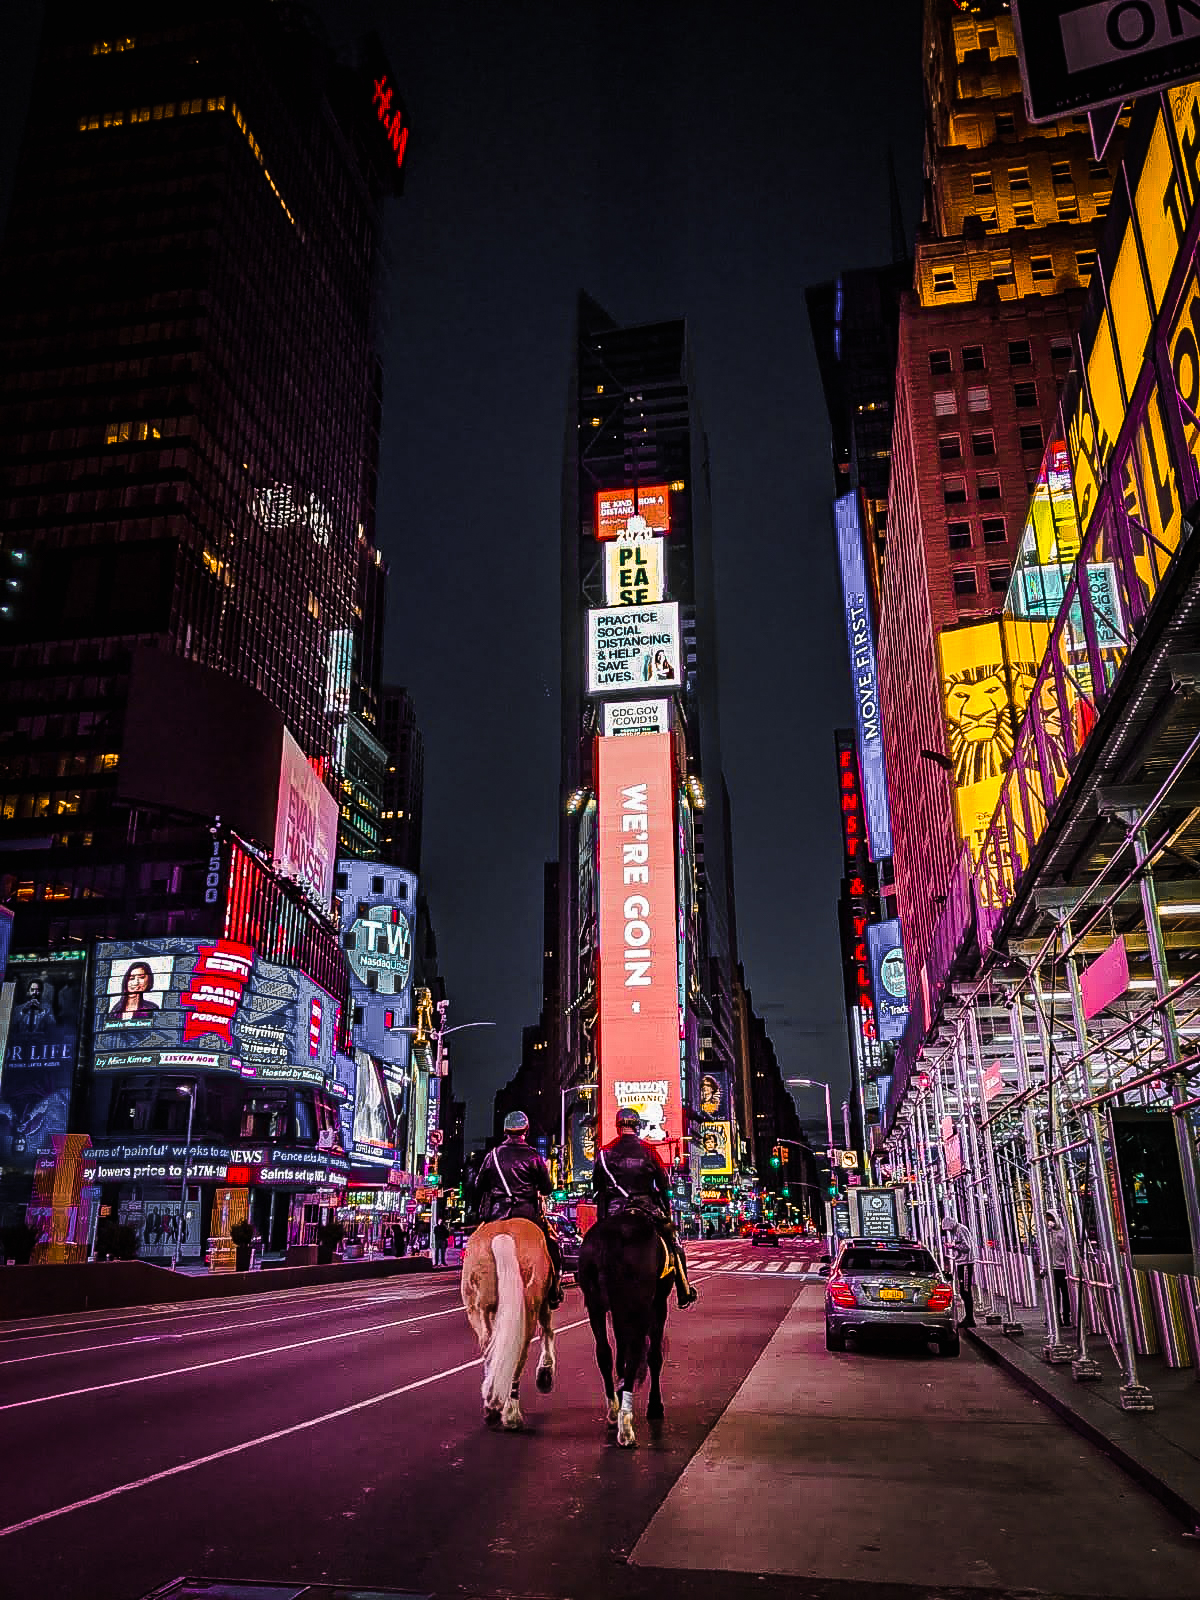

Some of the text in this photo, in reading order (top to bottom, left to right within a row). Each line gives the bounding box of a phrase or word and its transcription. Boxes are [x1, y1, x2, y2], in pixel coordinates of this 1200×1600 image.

[597, 612, 658, 627] PRACTICE
[597, 625, 642, 638] SOCIAL
[597, 633, 671, 649] DISTANCING
[597, 648, 641, 660] & HELP
[597, 661, 629, 672] SAVE
[597, 672, 635, 684] LIVES.
[611, 706, 658, 718] CDC.GOV
[858, 672, 879, 740] MOVE
[612, 715, 658, 726] /COVID19
[621, 784, 649, 885] WE'RE
[360, 955, 391, 970] Nasdaq
[262, 1068, 292, 1078] Hosted
[614, 1080, 670, 1097] HORIZON
[619, 1094, 663, 1105] ORGANIC
[230, 1150, 264, 1163] NEWS
[98, 1166, 131, 1178] lowers
[133, 1164, 166, 1179] price
[168, 1165, 182, 1176] to
[260, 1168, 294, 1180] Saints
